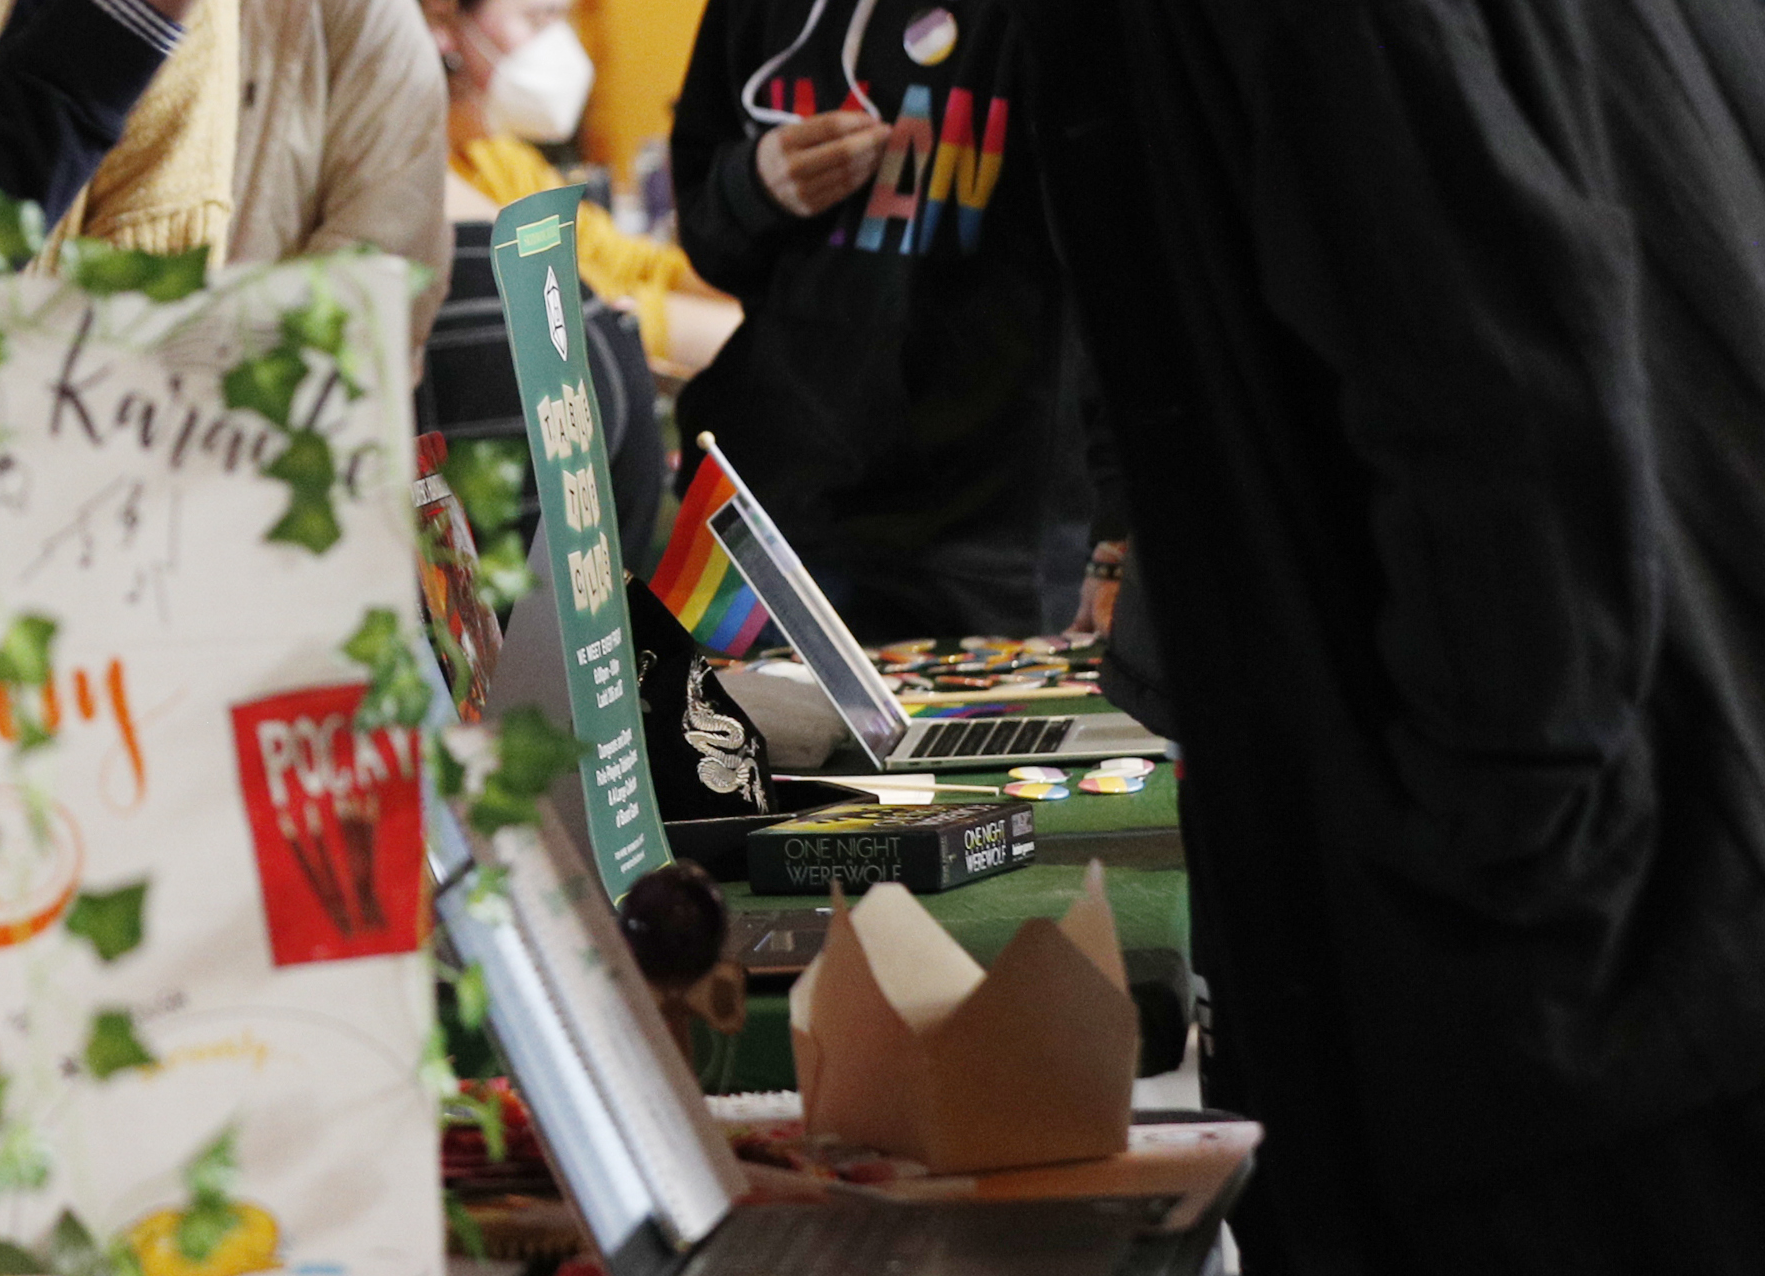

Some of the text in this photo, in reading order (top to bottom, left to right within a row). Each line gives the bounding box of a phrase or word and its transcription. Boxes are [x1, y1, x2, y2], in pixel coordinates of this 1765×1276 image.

[566, 474, 598, 521] TOP
[785, 836, 901, 859] ONE NIGHT
[964, 826, 983, 850] ONE
[982, 819, 1006, 844] NIGHT
[965, 844, 1007, 875] WEREWOLF
[785, 864, 902, 887] WEREWOLF
